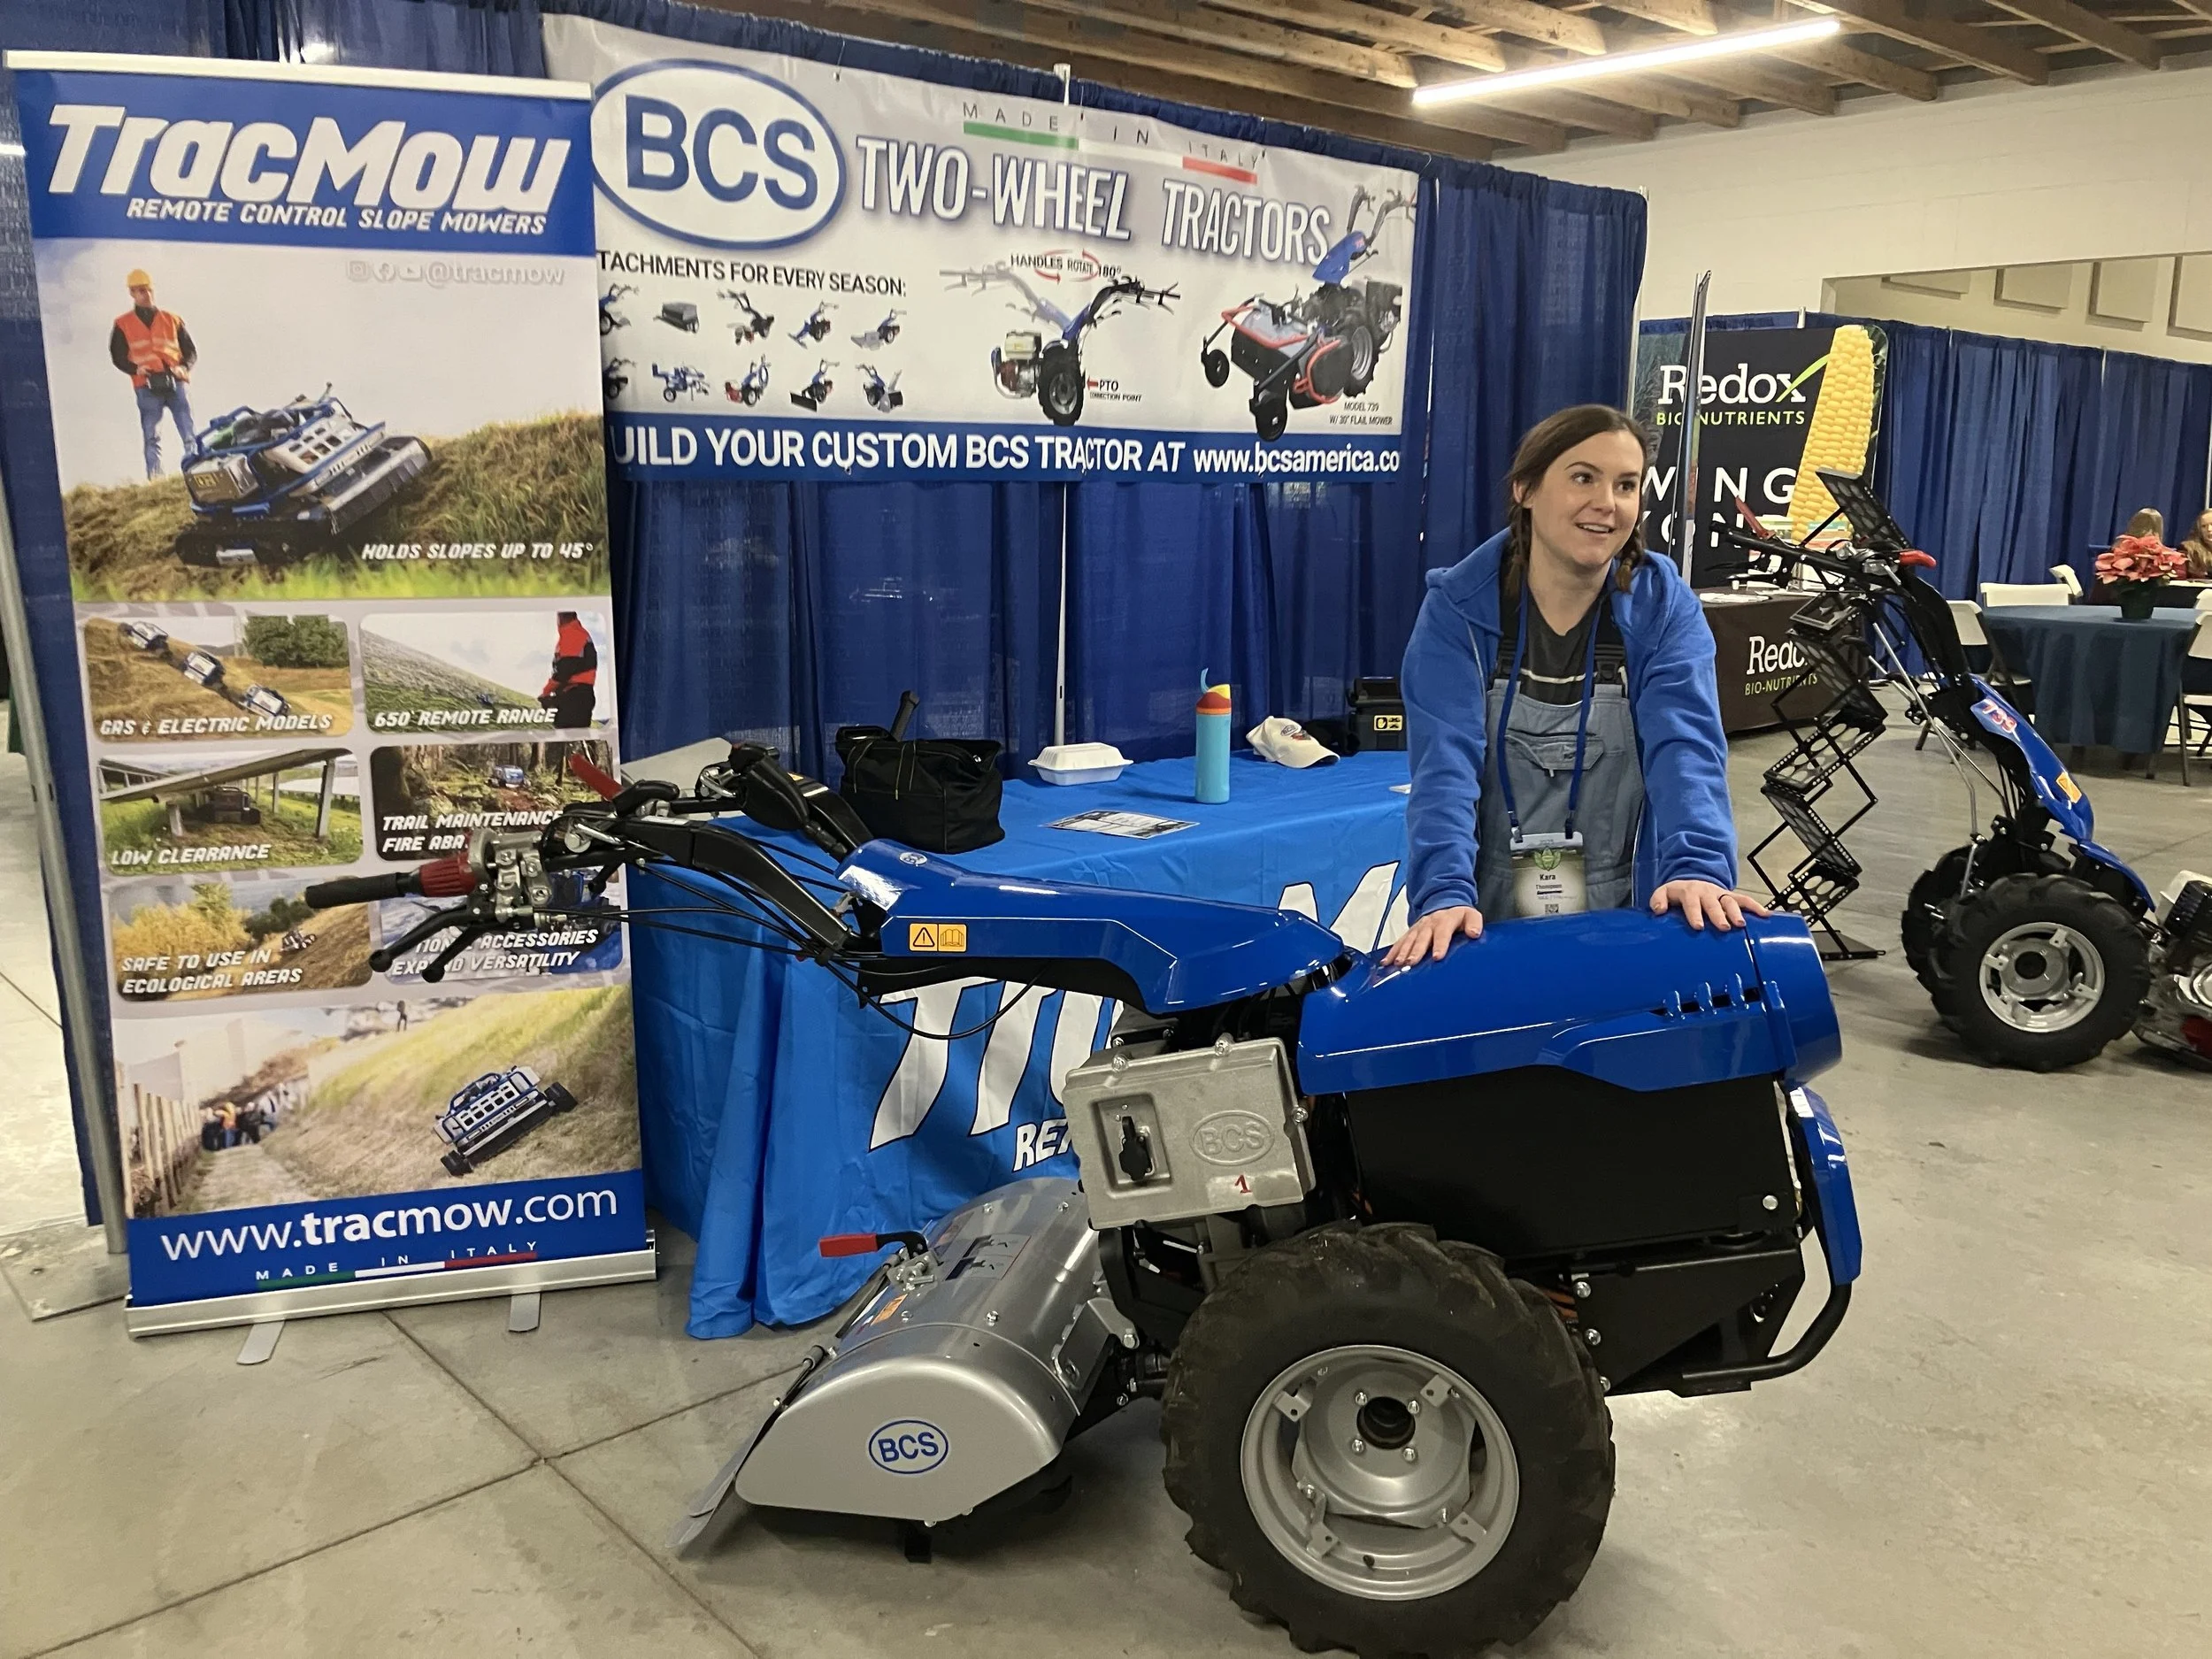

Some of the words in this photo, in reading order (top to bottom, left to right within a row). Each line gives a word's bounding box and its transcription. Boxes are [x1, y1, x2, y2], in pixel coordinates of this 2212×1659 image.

[963, 102, 1058, 131] MADE
[1113, 126, 1149, 145] IN
[1188, 141, 1258, 169] ITALY
[625, 93, 818, 211] BCS
[856, 134, 1132, 241] TWO-WHEEL
[1162, 179, 1332, 265] TRACTORS
[127, 196, 231, 223] REMOTE
[240, 203, 348, 229] CONTROL
[358, 209, 432, 233] SLOPE
[440, 212, 548, 235] MOWERS
[426, 261, 565, 288] @tracmow
[596, 249, 726, 281] TACHMENTS
[730, 263, 768, 285] FOR
[773, 266, 826, 291] EVERY
[829, 273, 907, 297] SEASON:
[1010, 253, 1063, 270] HANDLES
[1067, 258, 1094, 274] ROTATE
[1099, 379, 1119, 392] PTO
[1658, 363, 1807, 405] Redox
[1344, 401, 1366, 411] MODEL
[1656, 411, 1805, 426] BINUTRIENTS
[1350, 415, 1367, 425] FLAIL
[1369, 416, 1393, 425] MOWER
[611, 426, 698, 466] UILD
[705, 428, 805, 469] YOUR
[811, 431, 959, 470] CUSTOM
[966, 434, 1029, 470] BCS
[1040, 436, 1144, 472] TRACTOR
[1148, 442, 1186, 473] AT
[1194, 444, 1400, 475] www.bcsamerica.co
[361, 541, 422, 560] HOLDS
[426, 541, 496, 560] SLOPES
[500, 541, 526, 559] UP
[531, 541, 554, 559] TO
[1747, 635, 1808, 674] Redo
[100, 718, 136, 735] GAS
[158, 716, 252, 734] ELECTRIC
[256, 714, 333, 733] MODELS
[418, 709, 493, 726] REMOTE
[496, 707, 558, 724] RANGE
[382, 814, 429, 832] TRAIL
[111, 849, 154, 866] LOW
[160, 844, 273, 864] CLEARANCE
[381, 836, 426, 853] FIRE
[428, 834, 469, 850] ABA
[480, 929, 599, 949] ACCESSORIES
[120, 955, 173, 972] SAFE
[177, 953, 200, 970] TO
[205, 950, 245, 968] USE
[250, 948, 273, 964] IN
[392, 956, 465, 976] EXPD
[470, 951, 580, 971] VERSATILITY
[122, 973, 233, 995] ECOLOGICAL
[241, 968, 303, 987] AREAS
[1197, 1119, 1267, 1156] BCS
[1232, 1173, 1252, 1194] 1
[161, 1188, 618, 1263] www.tracmow.com
[256, 1262, 339, 1280] MADE
[380, 1255, 409, 1267] IN
[449, 1241, 538, 1260] ITALY
[878, 1431, 940, 1463] BCS
